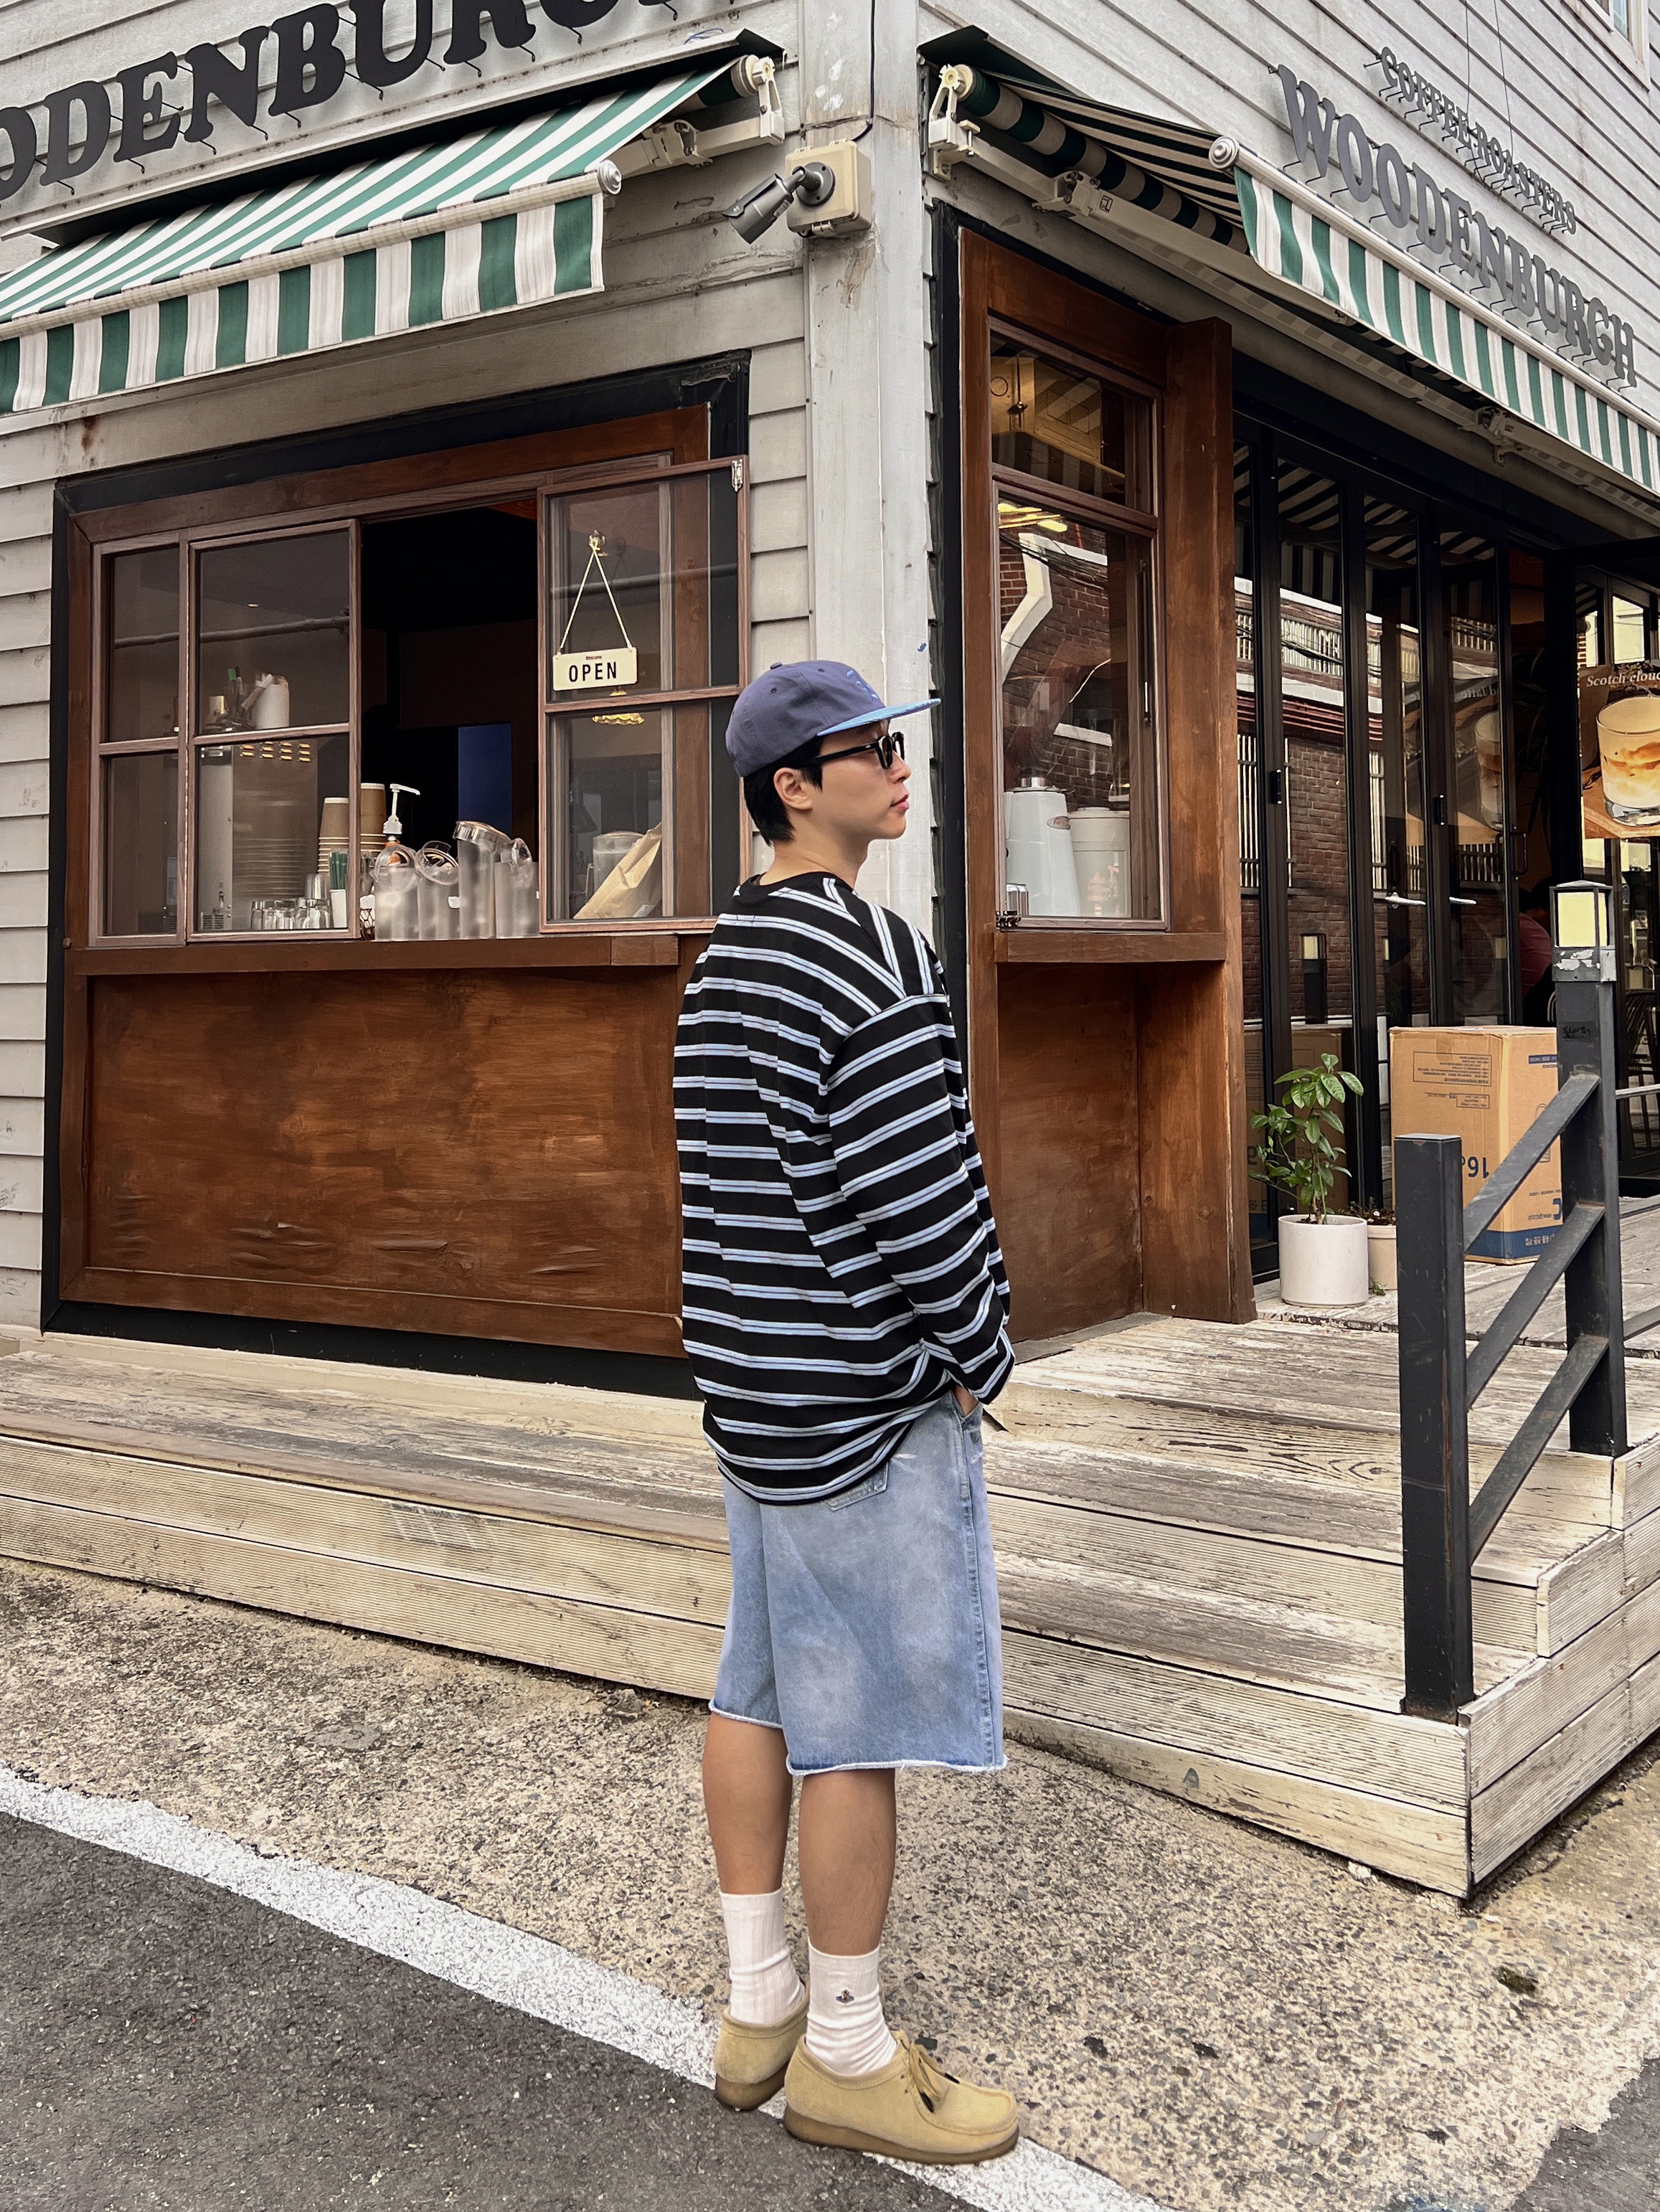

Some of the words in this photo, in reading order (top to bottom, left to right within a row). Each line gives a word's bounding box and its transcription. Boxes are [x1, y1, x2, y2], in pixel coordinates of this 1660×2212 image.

[1381, 47, 1471, 149] COFFEE
[1475, 121, 1577, 235] ROASTERS
[1278, 65, 1636, 387] WOODENBURGH
[569, 661, 616, 682] OPEN
[1586, 673, 1626, 687] Scotch
